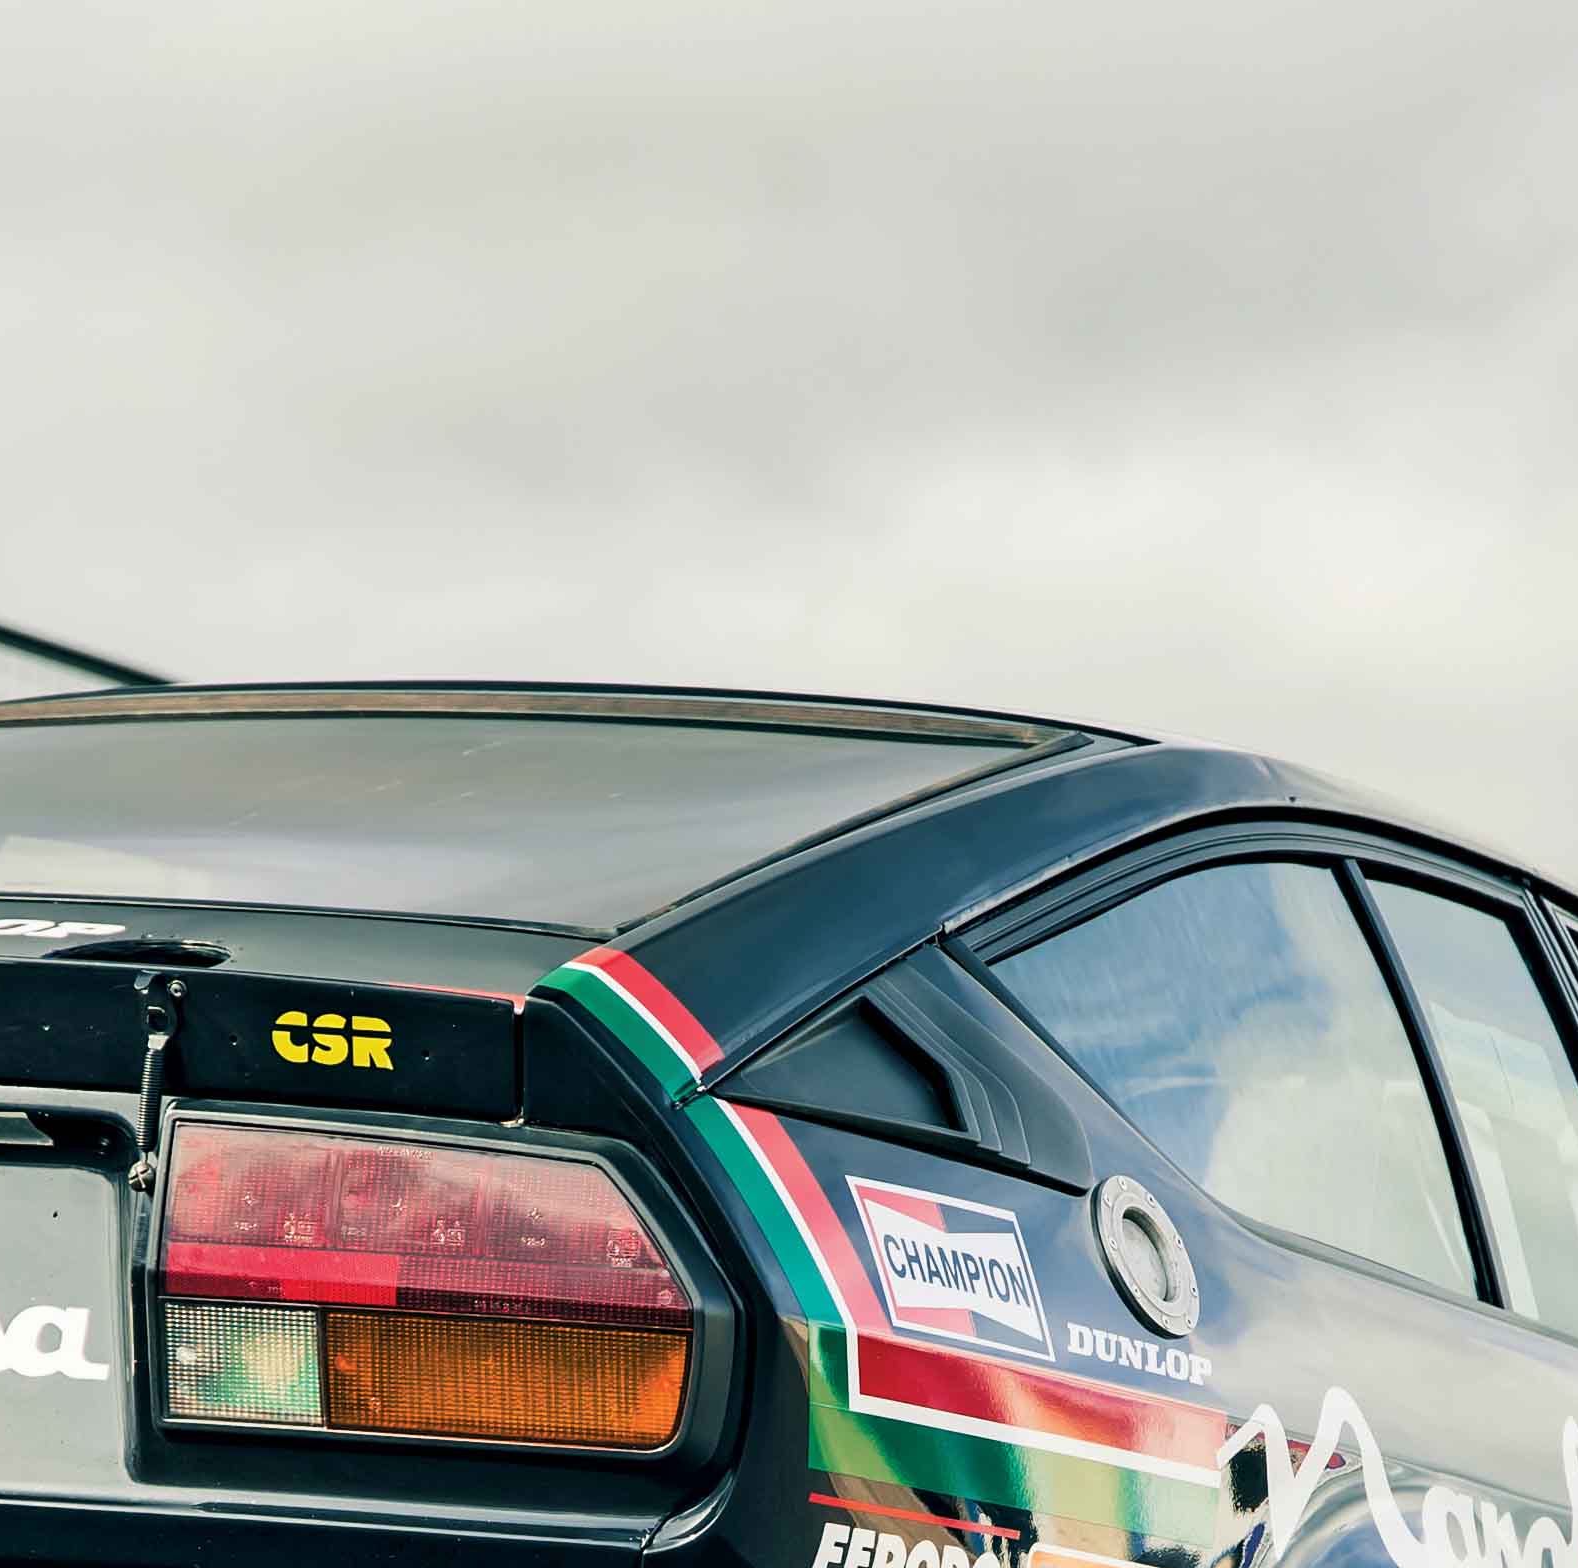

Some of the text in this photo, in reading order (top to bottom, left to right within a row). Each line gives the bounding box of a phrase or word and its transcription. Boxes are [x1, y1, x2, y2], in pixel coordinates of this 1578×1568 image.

[271, 1010, 395, 1070] CSR
[882, 1233, 1031, 1308] CHAMPION
[1066, 1322, 1213, 1387] DUNLOP
